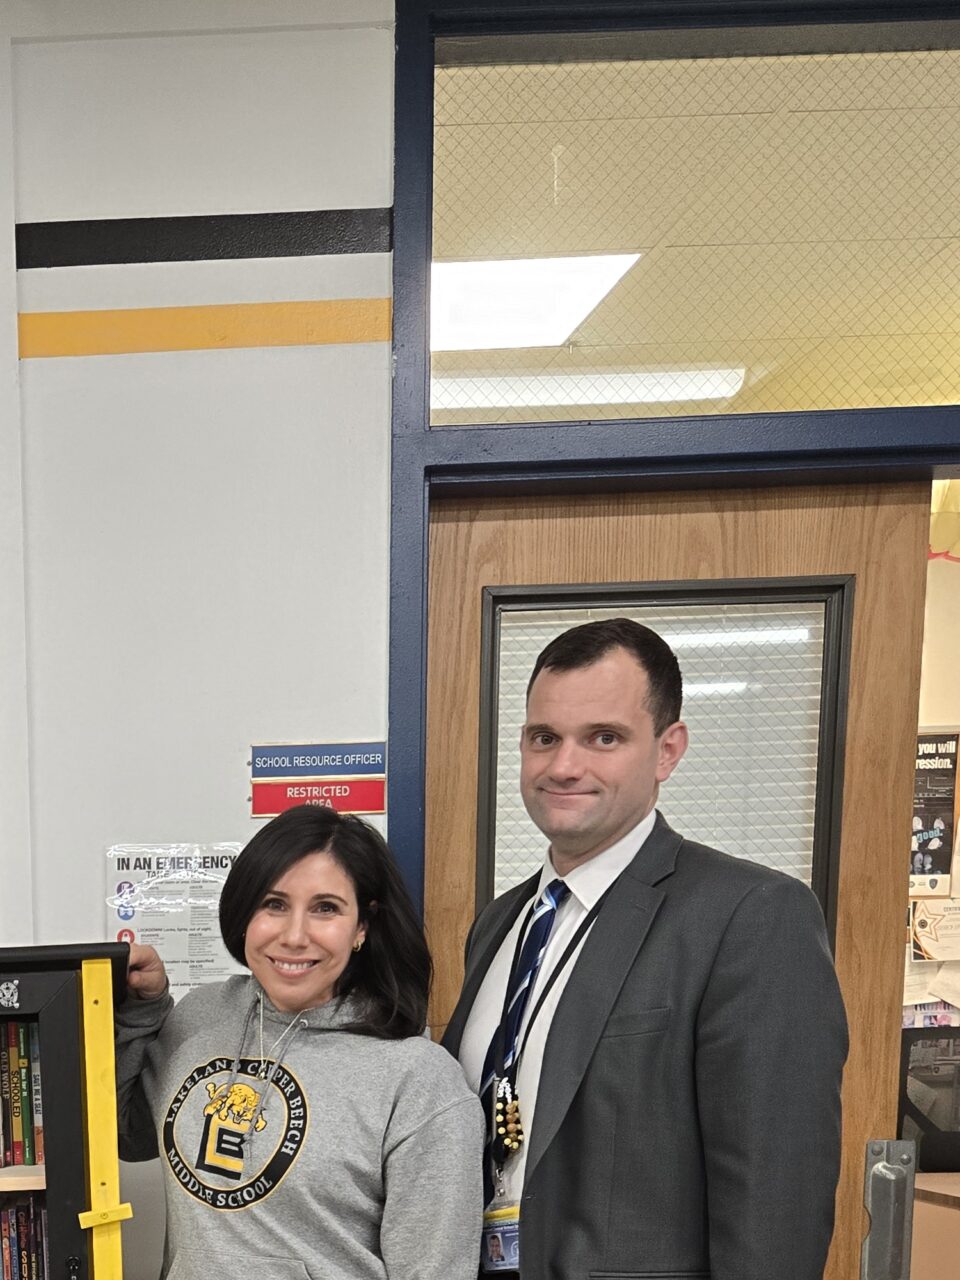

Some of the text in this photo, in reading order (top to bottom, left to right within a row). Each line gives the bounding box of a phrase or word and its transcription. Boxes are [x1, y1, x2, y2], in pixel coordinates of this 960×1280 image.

[918, 741, 956, 755] you will
[255, 754, 382, 768] SCHOOL RESOURCE OFFICER
[287, 786, 349, 797] RESTRICTED
[117, 858, 130, 870] IN
[133, 857, 151, 870] AN
[2, 1072, 10, 1100] WOLF
[12, 1070, 20, 1118] SCHOOLED
[166, 1059, 304, 1156] LAKELAND CPPER BEECH
[167, 1148, 214, 1204] MIDDLE
